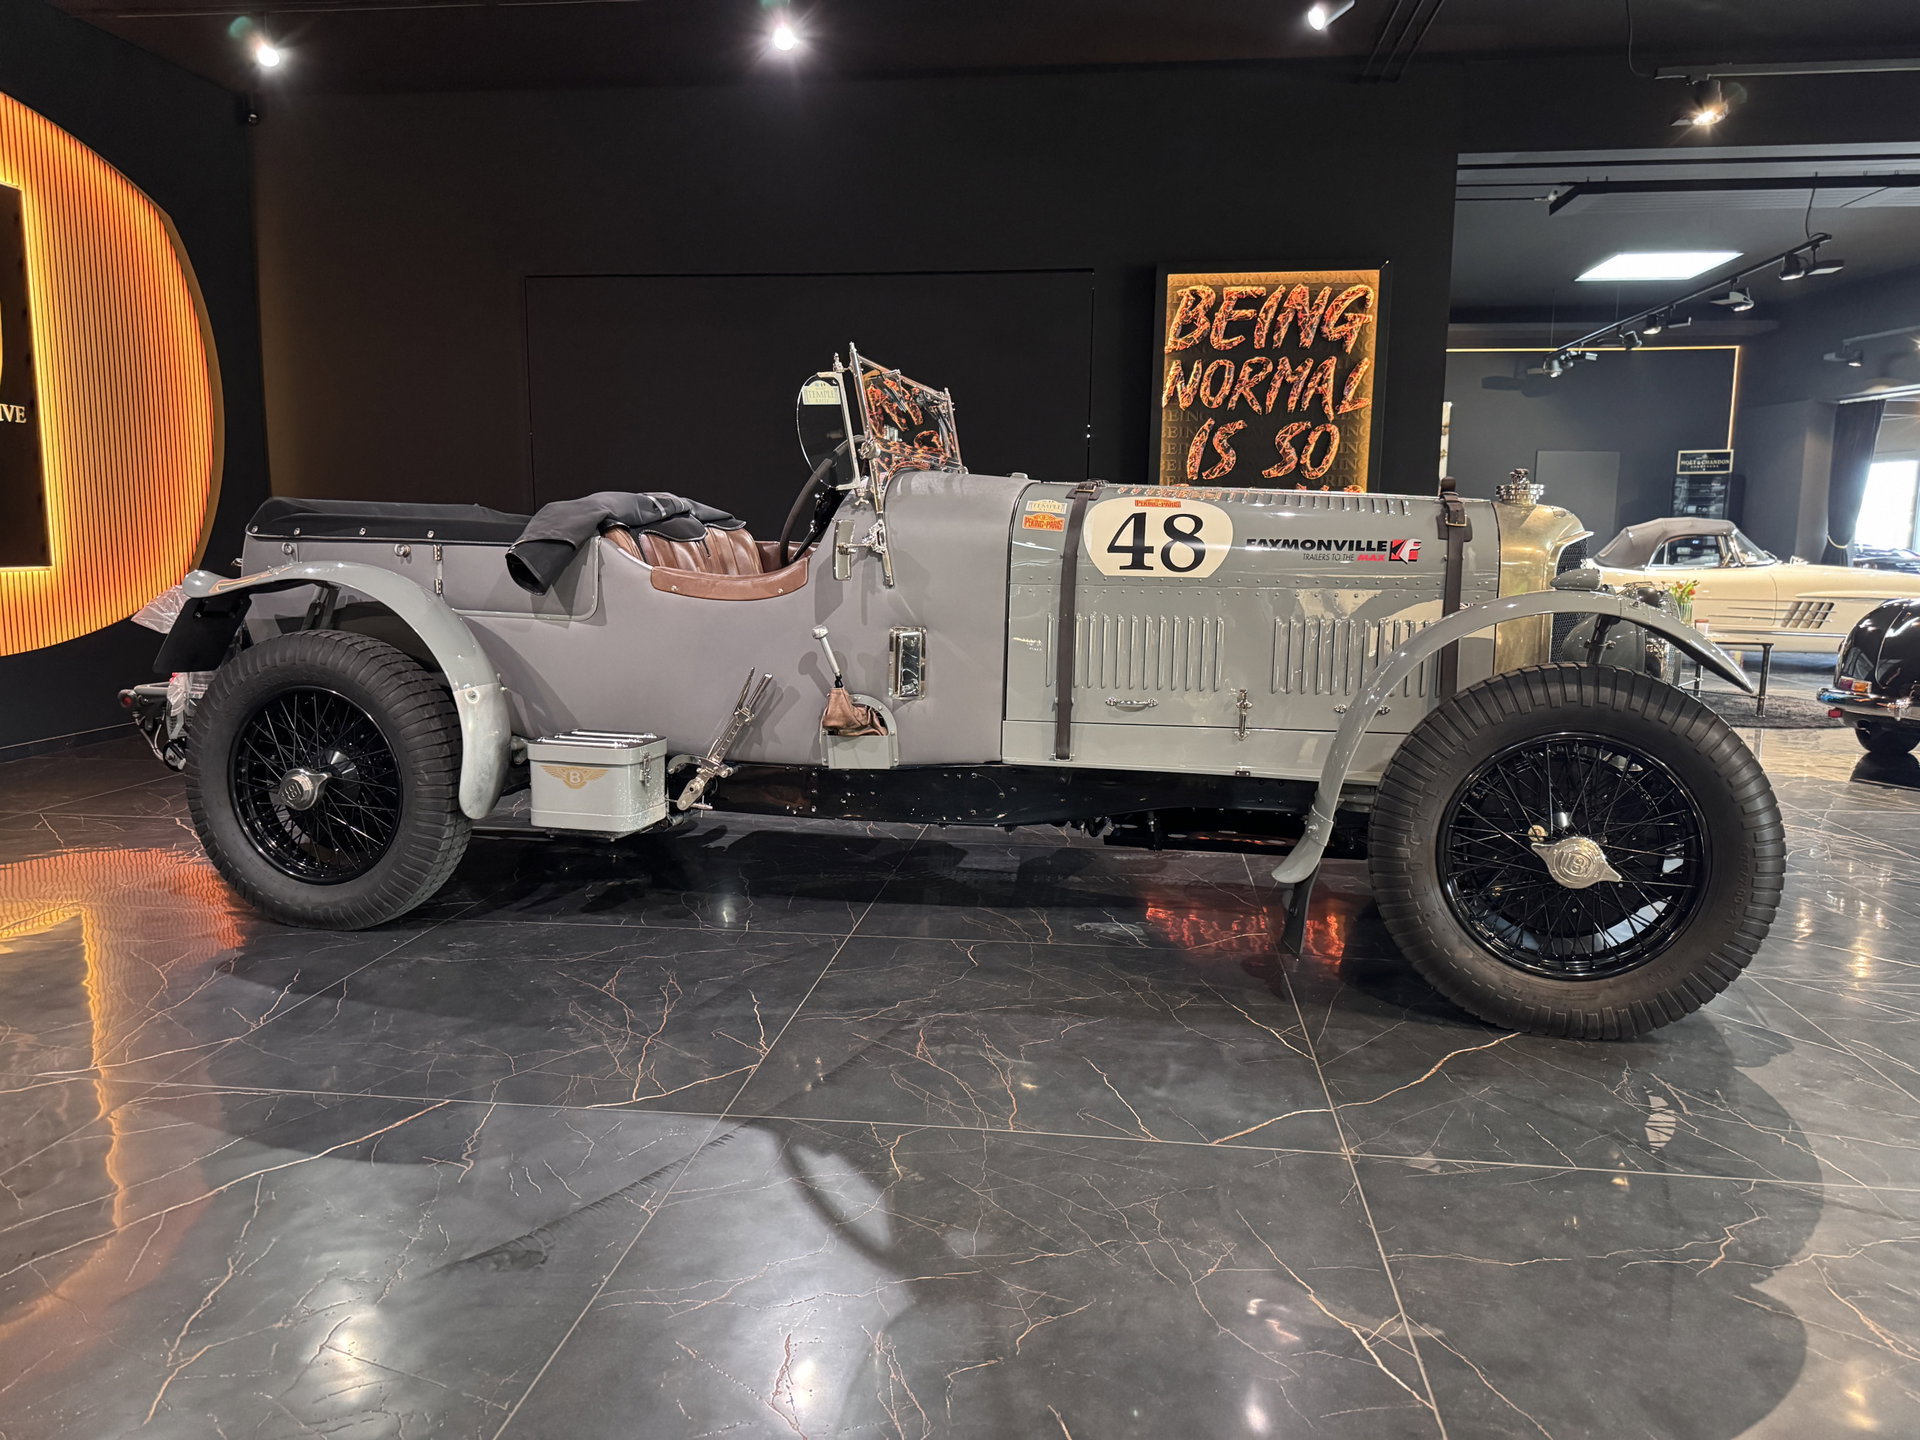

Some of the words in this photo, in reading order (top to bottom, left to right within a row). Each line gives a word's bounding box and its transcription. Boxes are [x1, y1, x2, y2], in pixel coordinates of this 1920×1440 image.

[1164, 283, 1375, 355] BEING
[1162, 355, 1373, 422] NORMAL
[1187, 417, 1248, 480] IS
[1261, 421, 1341, 480] SO
[1107, 511, 1206, 573] 48
[1245, 538, 1388, 552] FAYMONVILLE
[1303, 552, 1330, 561] TRAILERS
[1332, 553, 1341, 561] TO
[1356, 554, 1387, 562] MAX
[570, 771, 580, 784] B
